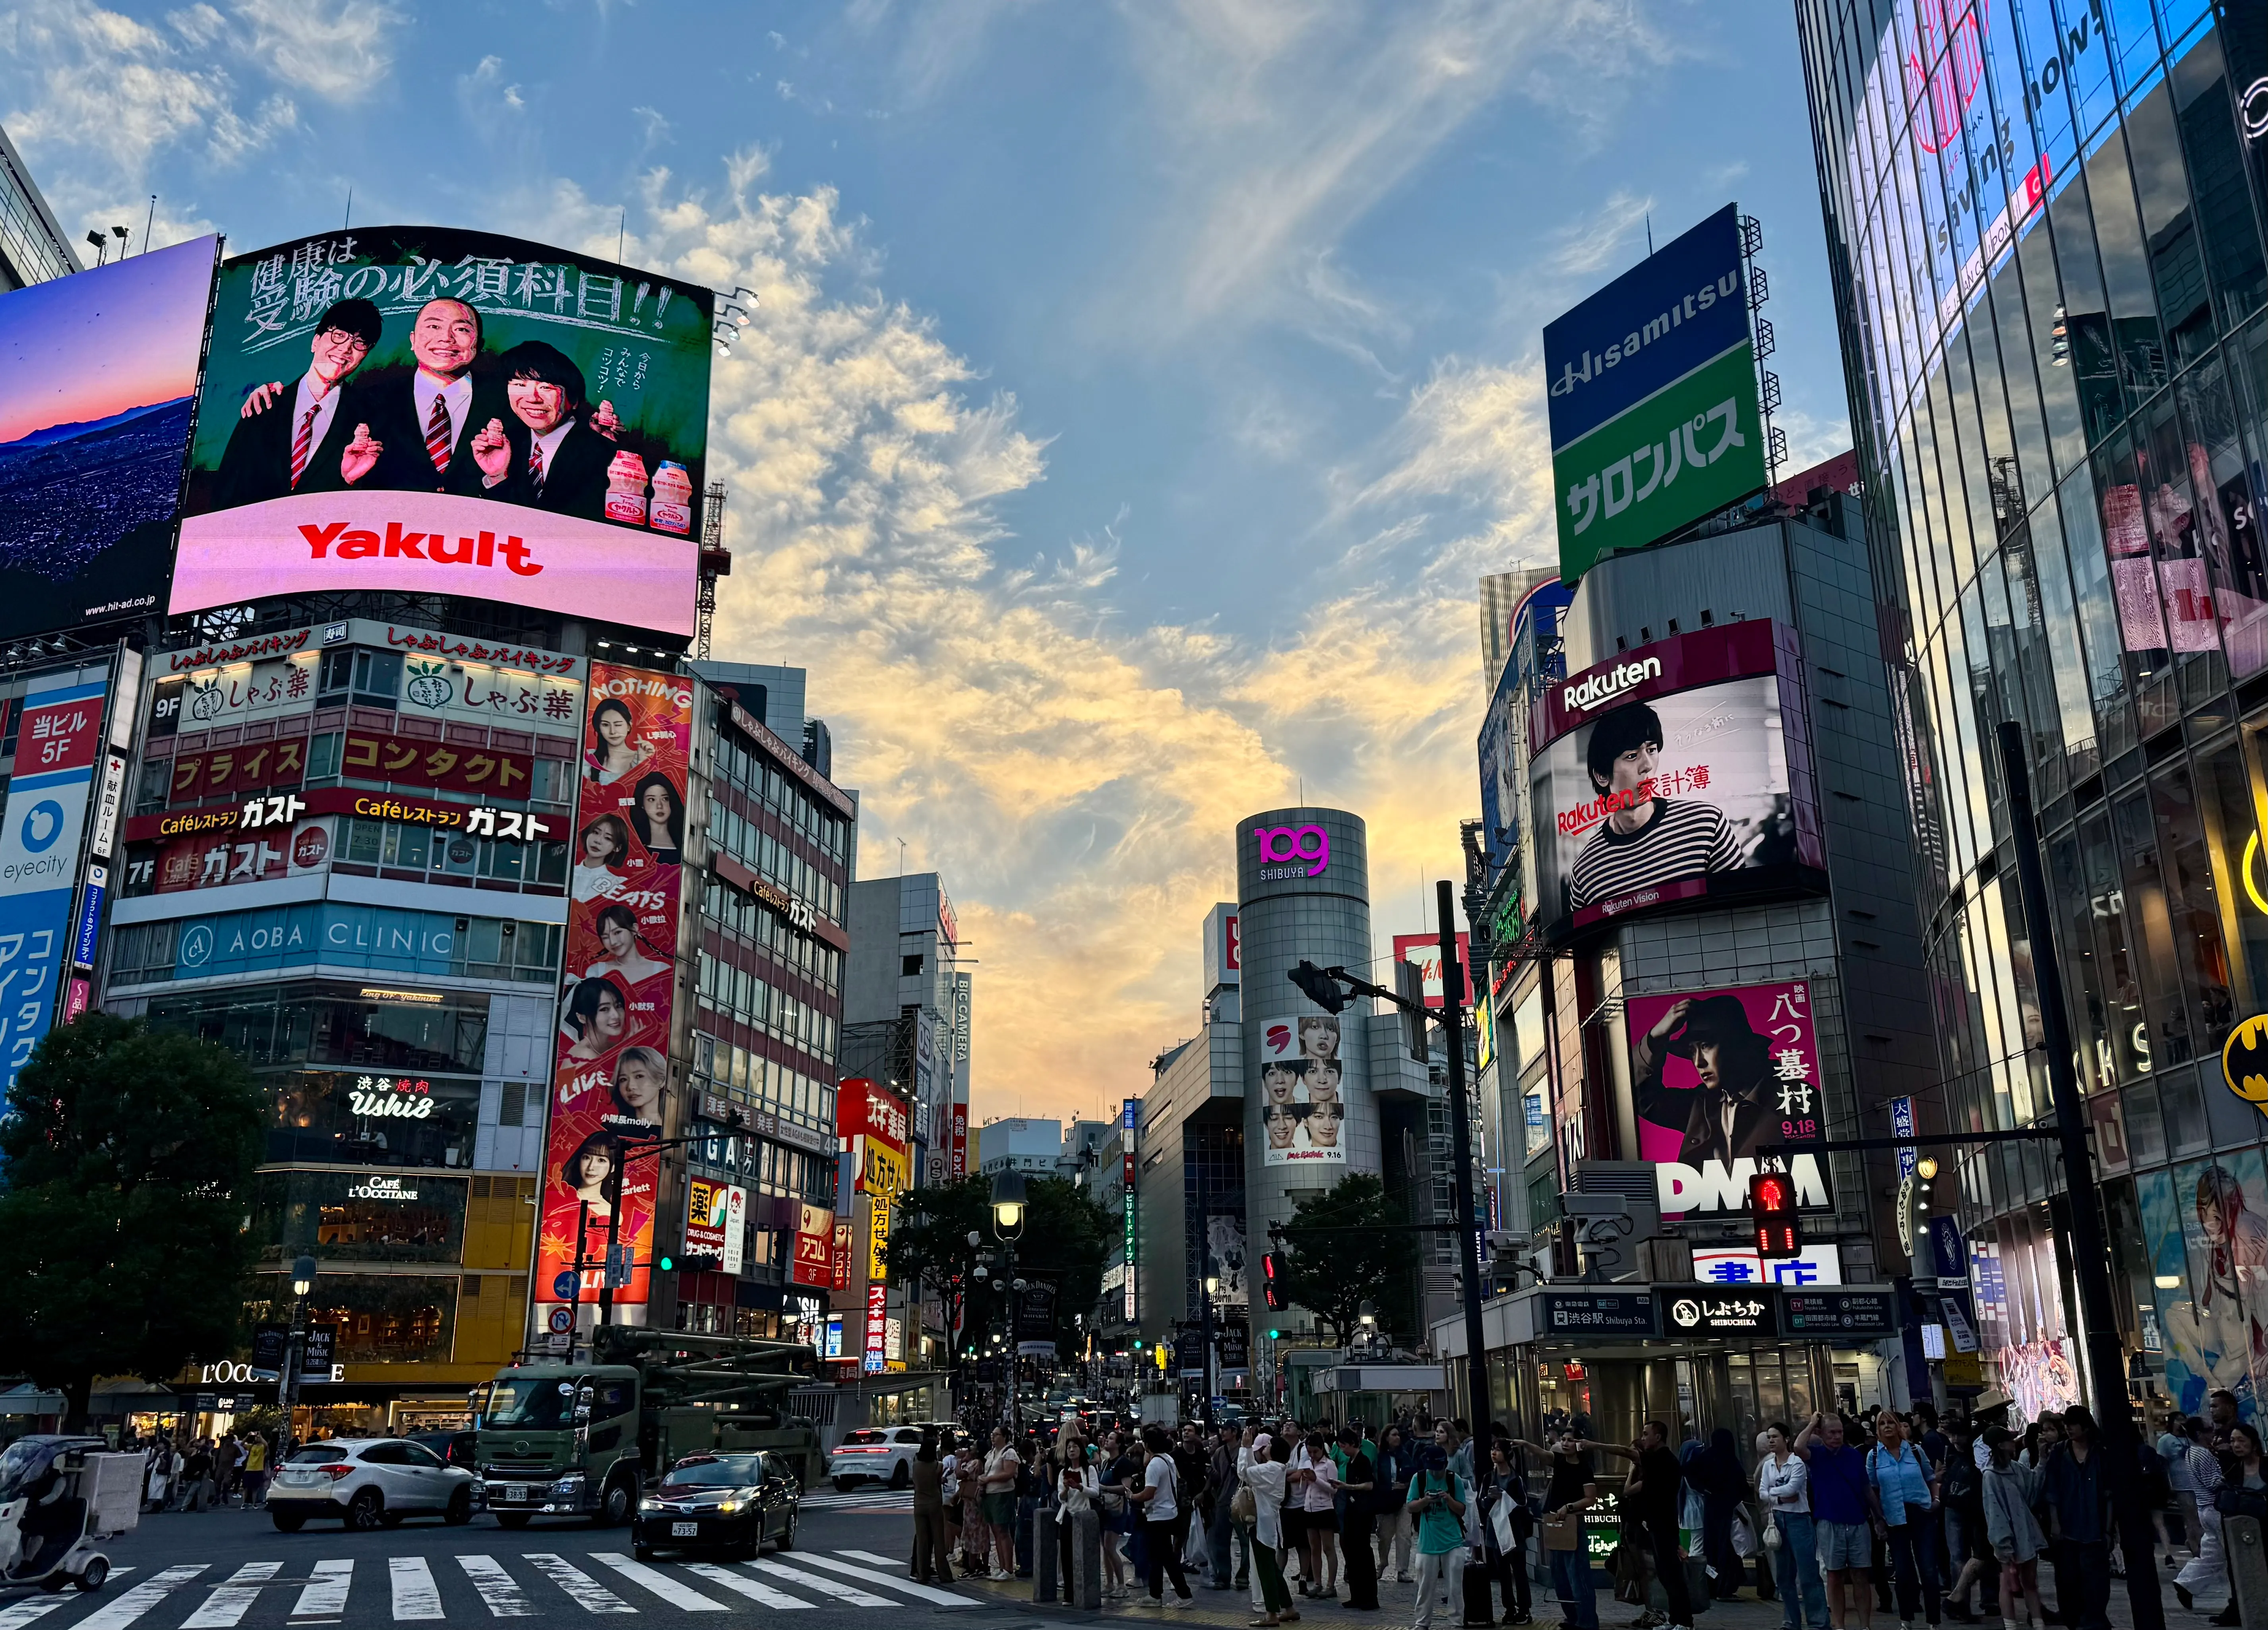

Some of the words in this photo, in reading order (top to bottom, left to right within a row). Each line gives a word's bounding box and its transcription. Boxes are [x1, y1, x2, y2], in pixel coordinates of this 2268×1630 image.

[251, 236, 356, 298] 健康は
[242, 254, 673, 343] 受験の必須科目!!
[1550, 269, 1737, 397] Hisamitsu
[597, 348, 613, 393] コツコツ!
[614, 348, 631, 387] みんなで
[633, 352, 651, 389] 今日から
[1567, 396, 1745, 536] サロンパス
[614, 504, 637, 514] ヤクルト
[297, 522, 544, 576] Yakult
[85, 595, 155, 616] www.hit-ad.co.jp
[326, 624, 345, 640] 寿司
[170, 629, 311, 670] しゃぶしゃぶバイキング
[388, 626, 576, 673] しゃぶしゃぶバイキング
[229, 667, 310, 707] しゃぶ葉
[465, 676, 573, 720] しゃぶ葉
[592, 677, 693, 708] NOTHING
[1564, 656, 1661, 712] Rakuten
[156, 697, 180, 718] 9F
[32, 711, 87, 740] 当ビル
[41, 738, 71, 763] 5F
[742, 710, 811, 778] しゃぶしゃぶバイキング
[176, 743, 301, 790] プライス
[346, 738, 525, 786] コンタクト
[99, 780, 118, 844] 献血ルーム
[241, 794, 306, 829] ガスト
[1557, 788, 1633, 836] Rakuten
[1637, 764, 1711, 802] 家計簿
[355, 824, 380, 832] OPEN
[467, 807, 549, 841] ガスト
[97, 847, 107, 855] 6F
[165, 853, 199, 873] Café
[201, 841, 281, 885] ガスト
[298, 844, 324, 858] ガスト
[1254, 824, 1330, 877] 109
[4, 855, 67, 883] eyecity
[129, 861, 154, 884] 7F
[1260, 867, 1304, 881] SHIBUYA
[591, 876, 666, 910] BEATS
[1602, 898, 1633, 915] Rakuten
[1633, 892, 1660, 904] Vision
[789, 898, 817, 933] ガスト
[230, 923, 302, 953] AOBA
[328, 923, 451, 954] CLINIC
[959, 980, 968, 1001] BIC
[1793, 984, 1805, 1003] 映画
[919, 1025, 931, 1059] OS
[957, 1004, 968, 1061] CAMERA
[1766, 993, 1813, 1115] 八つ墓村
[357, 1076, 391, 1092] 渋谷
[396, 1079, 429, 1094] 焼肉
[560, 1071, 613, 1103] LIVE
[349, 1091, 434, 1119] Ushi8
[707, 1096, 726, 1117] 薄毛
[756, 1113, 774, 1134] 発毛
[868, 1095, 906, 1146] スギ薬局
[955, 1115, 965, 1136] 免税
[1782, 1119, 1816, 1134] 9.18
[824, 1136, 838, 1157] 4F
[865, 1144, 905, 1193] 処方せん
[931, 1159, 942, 1179] OS
[621, 1183, 651, 1196] carlett
[691, 1186, 709, 1222] 薬
[1897, 1180, 1911, 1254] 渋谷センター街
[688, 1228, 699, 1237] DRUG
[704, 1231, 724, 1242] COSMETIC
[802, 1237, 825, 1261] アコム
[686, 1241, 724, 1261] サンドラッグ
[835, 1252, 844, 1278] アコム
[808, 1269, 817, 1282] 3F
[1209, 1295, 1232, 1304] utumn
[1702, 1301, 1765, 1317] しぶちか
[868, 1287, 886, 1349] スギ薬局
[1224, 1326, 1242, 1338] JACK
[1569, 1313, 1604, 1324] 渋谷駅
[1606, 1317, 1633, 1326] Shibuya
[308, 1330, 331, 1342] JACK
[1224, 1342, 1244, 1352] MUSIC
[307, 1347, 329, 1357] MUSIC
[201, 1359, 345, 1384] L'OCCE
